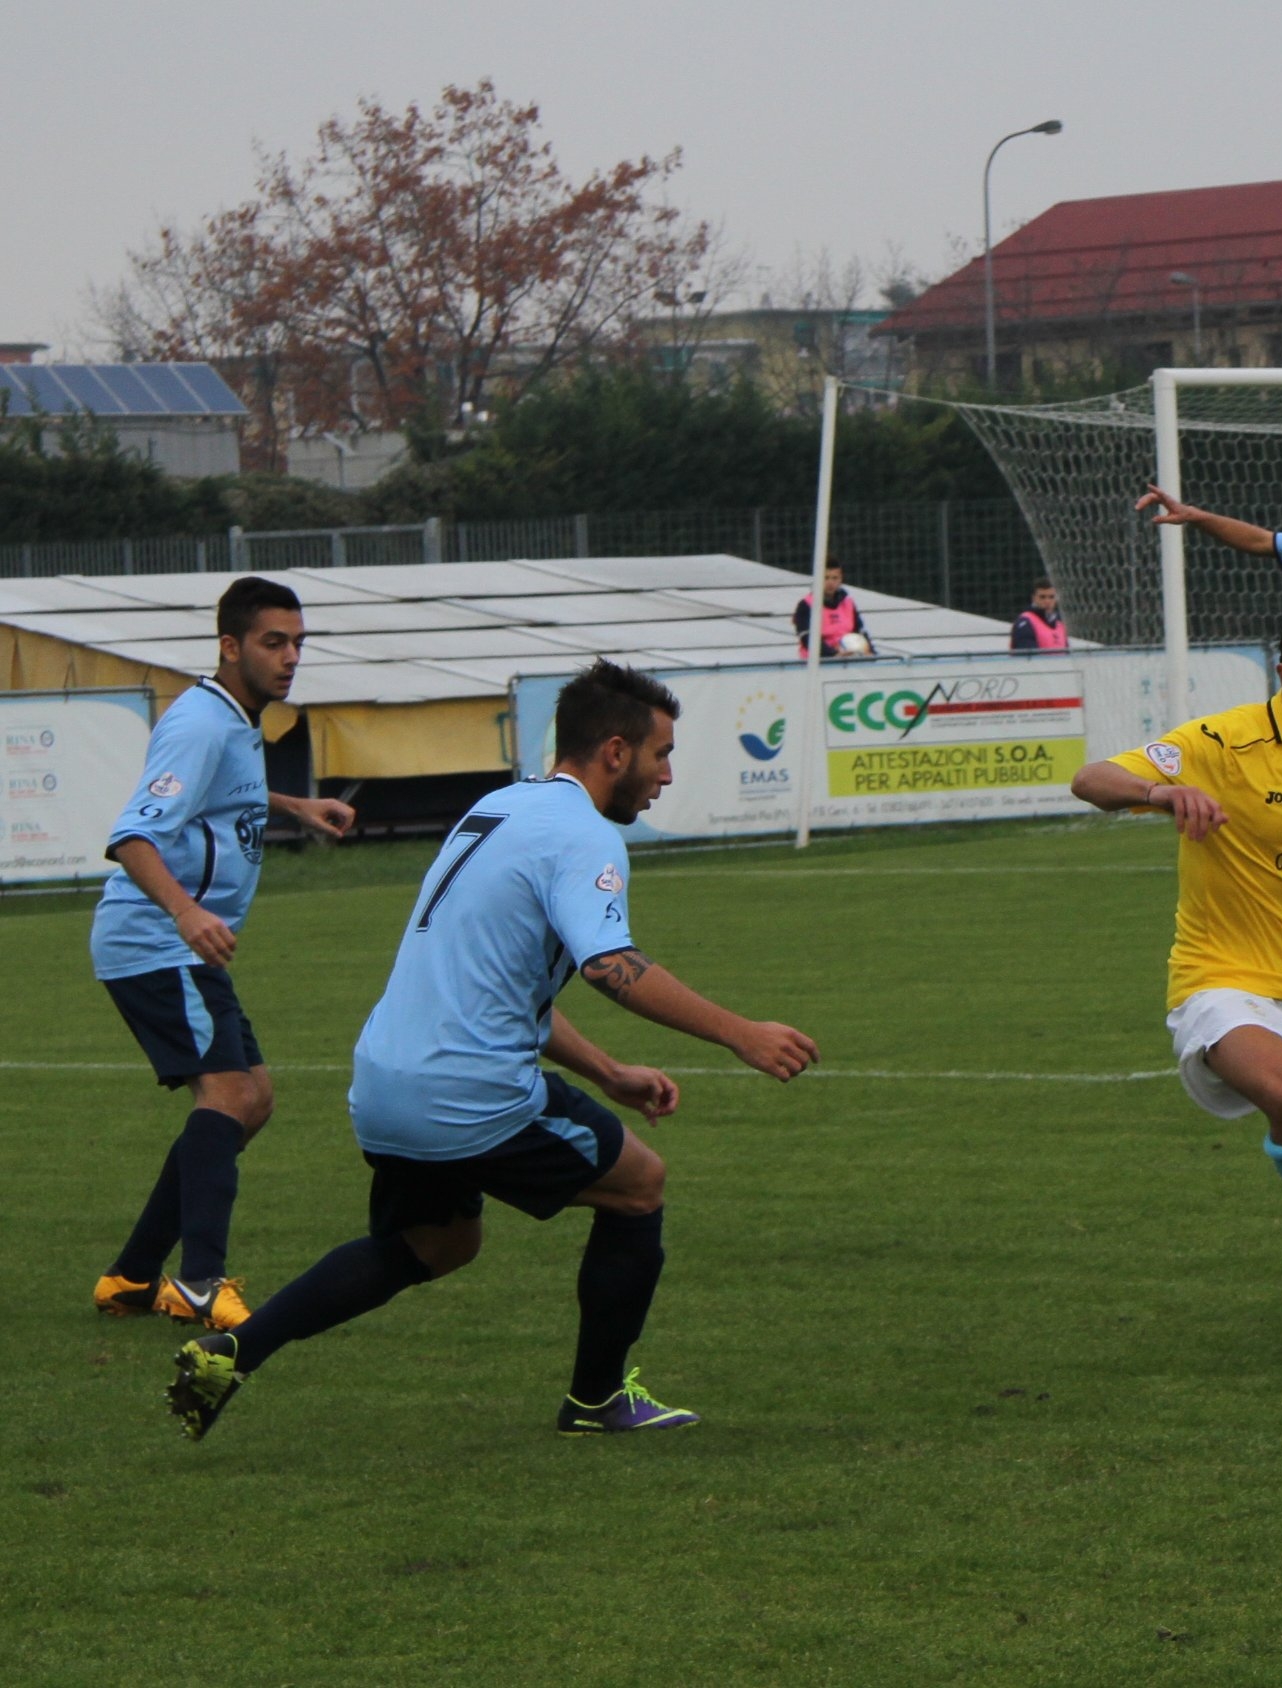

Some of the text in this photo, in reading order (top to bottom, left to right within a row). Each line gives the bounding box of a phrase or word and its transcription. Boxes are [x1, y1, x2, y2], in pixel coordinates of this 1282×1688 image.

[852, 744, 1054, 772] ATTESTAZIONI S.O.A.
[740, 768, 790, 785] EMAS
[855, 764, 1053, 791] PER APPALTI PUBBLICI
[416, 812, 510, 932] 7
